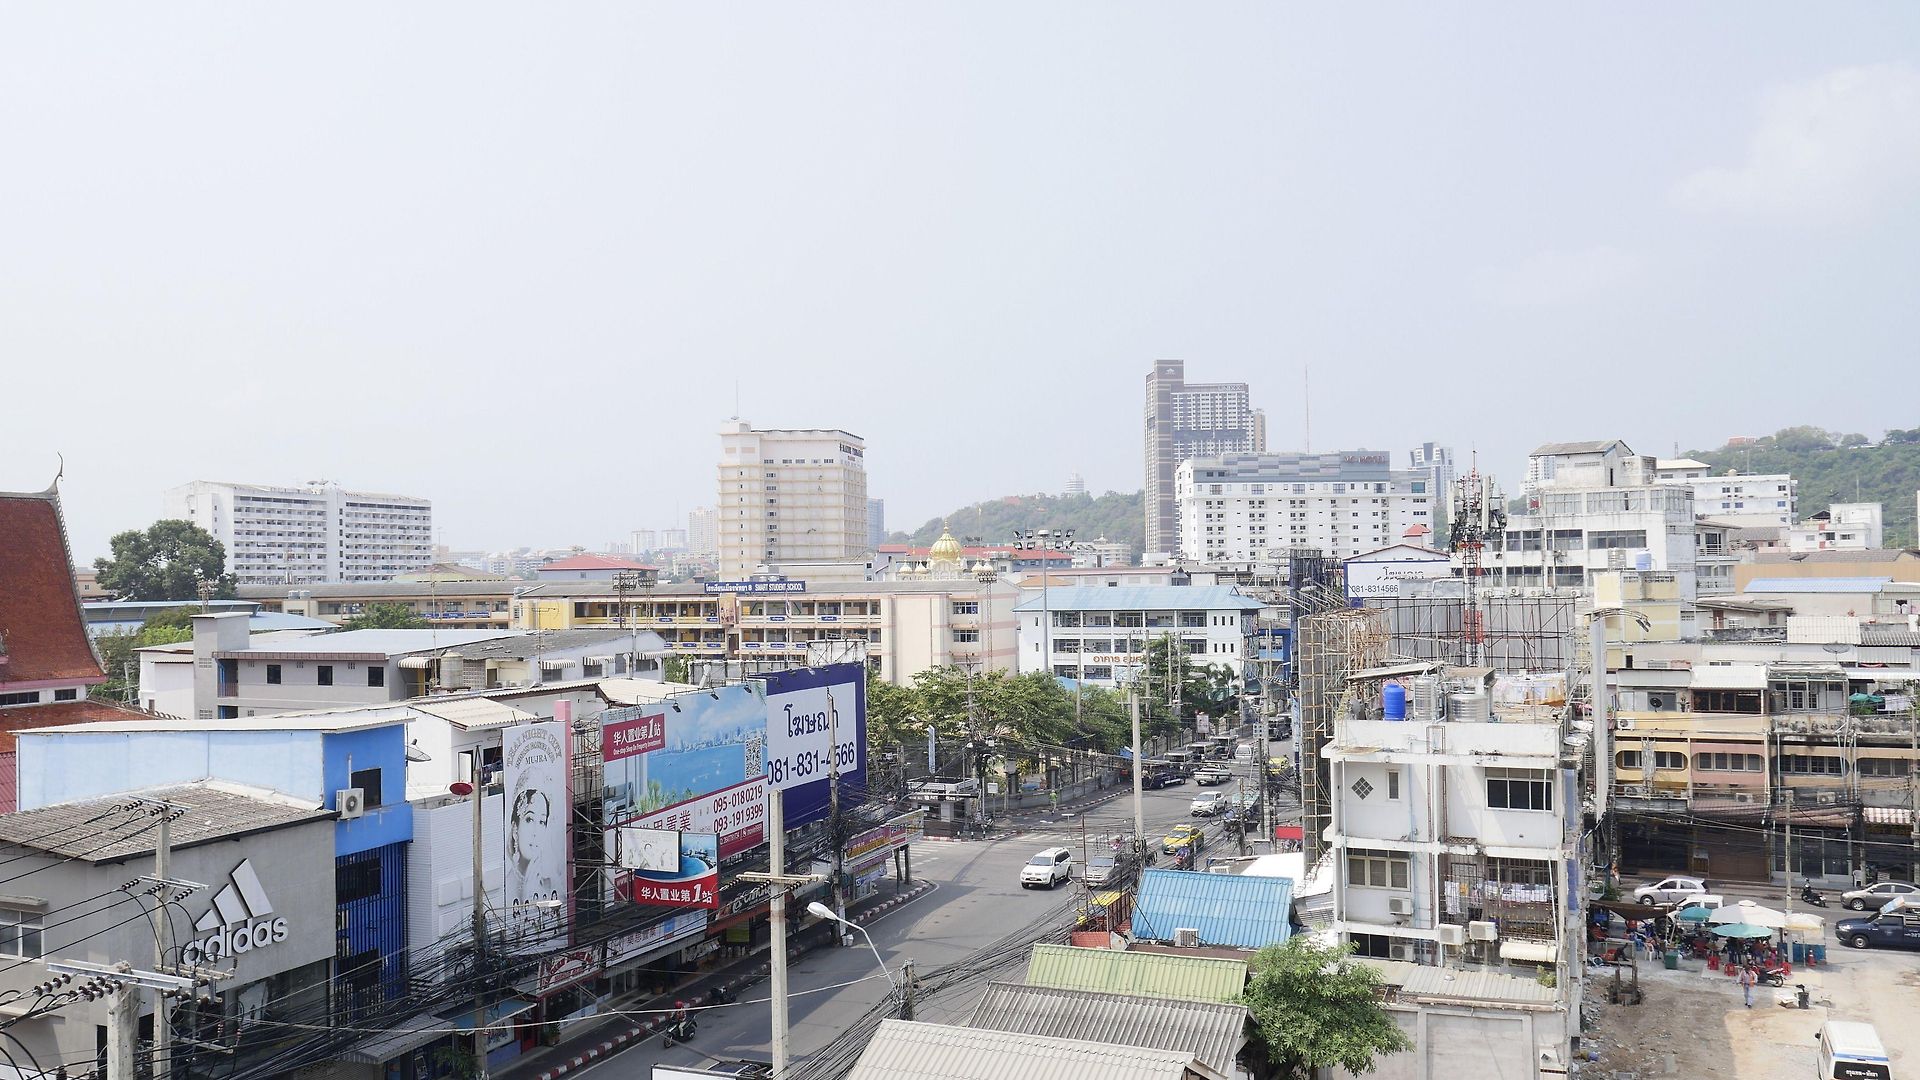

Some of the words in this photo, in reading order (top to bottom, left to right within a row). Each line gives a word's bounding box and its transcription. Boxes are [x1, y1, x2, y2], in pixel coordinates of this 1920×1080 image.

[769, 583, 786, 592] STUDENT
[787, 583, 804, 591] SCHOOL
[613, 718, 661, 746] 华人置业第1站
[641, 883, 713, 904] 华人置业第1站
[182, 917, 289, 967] adidas
